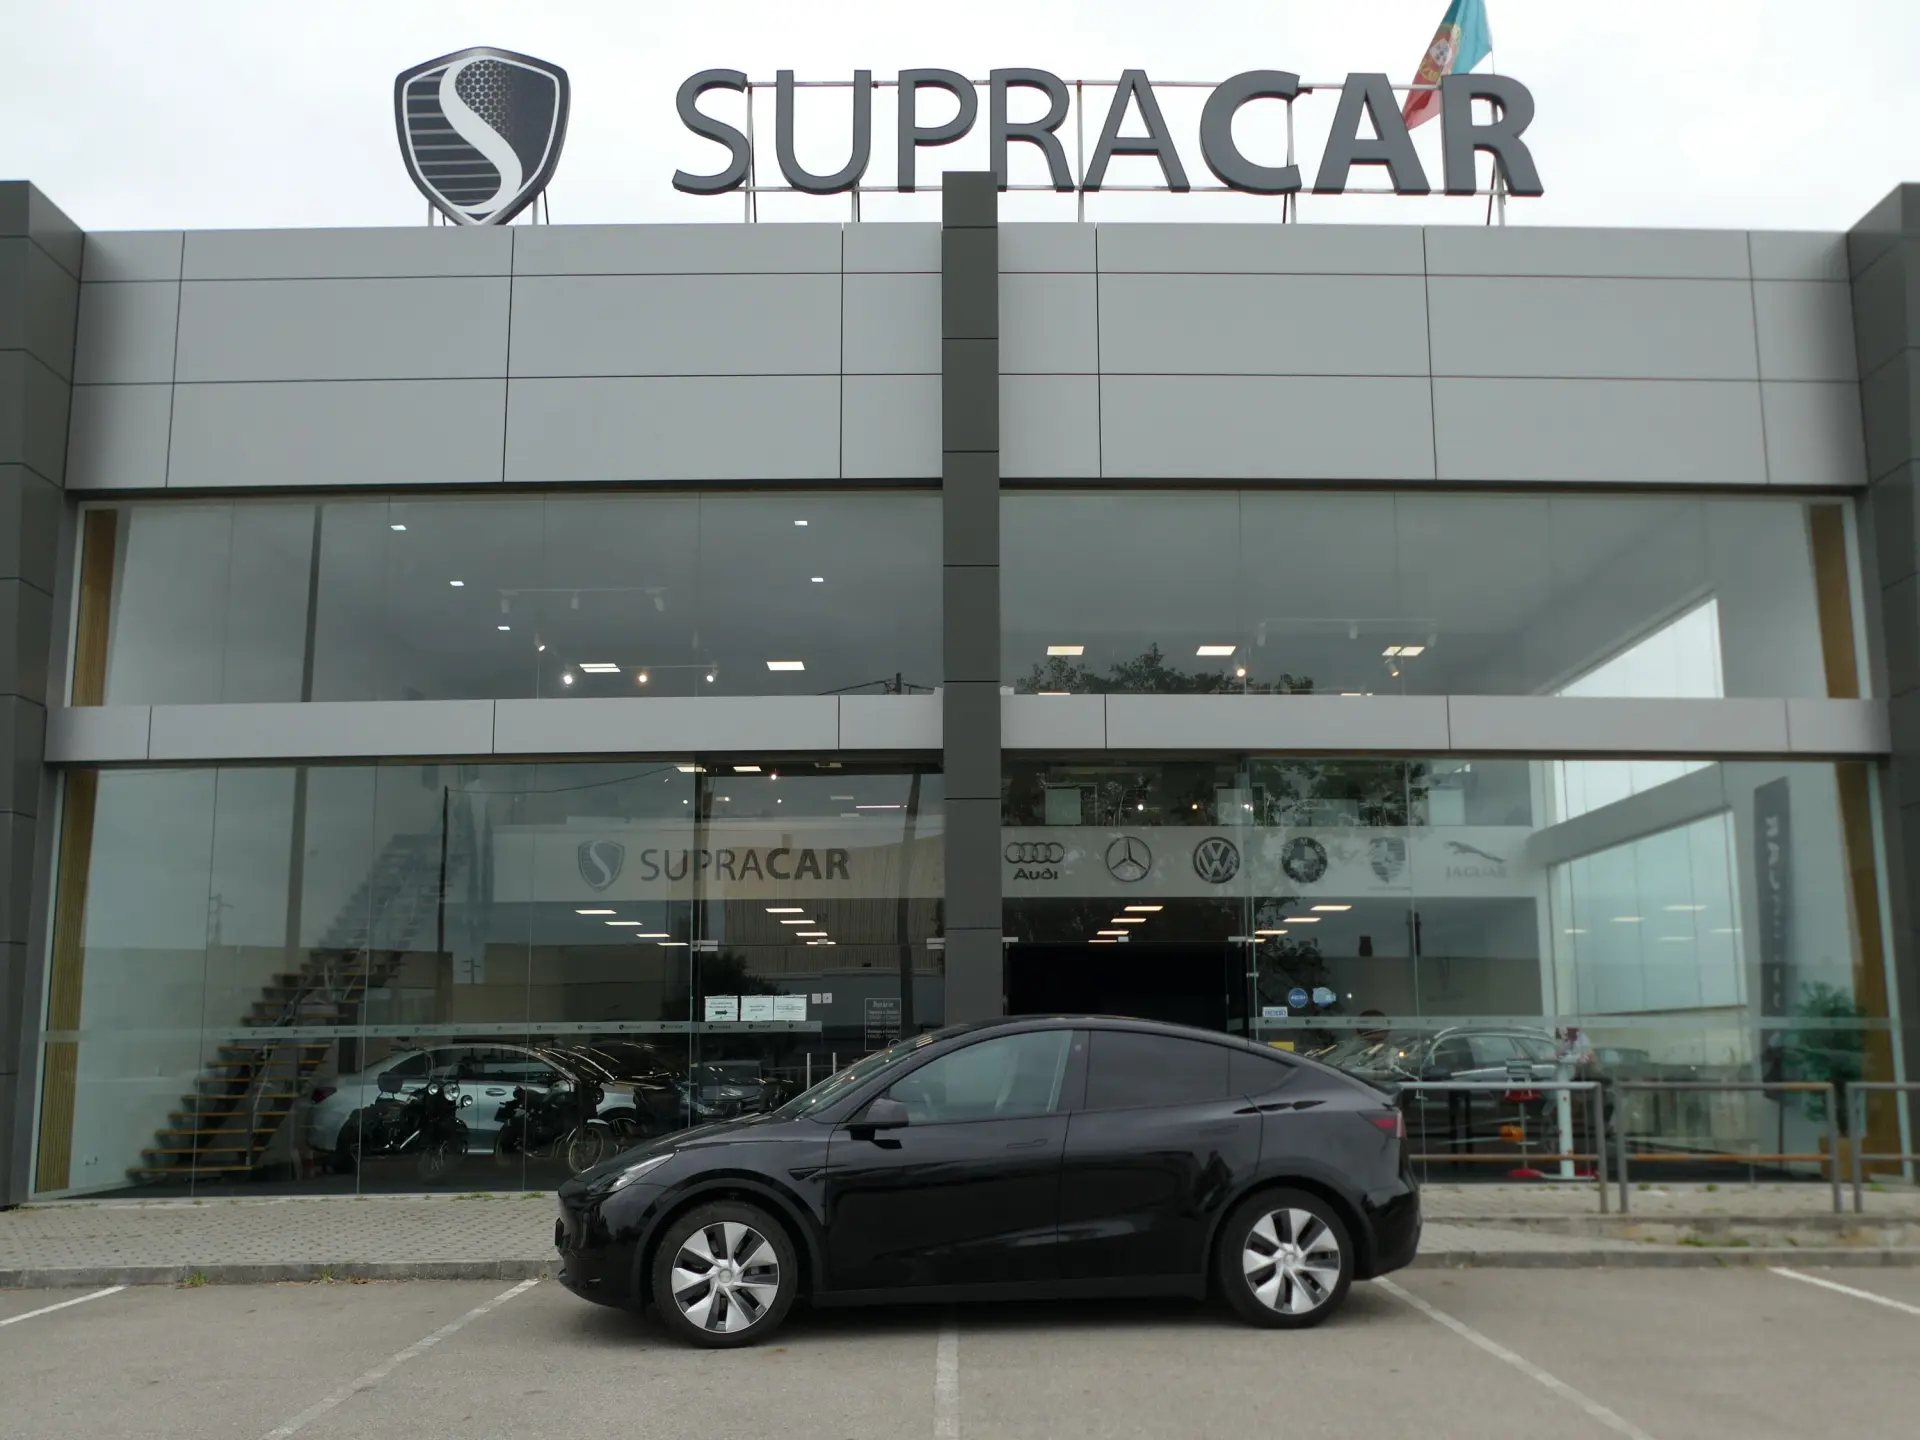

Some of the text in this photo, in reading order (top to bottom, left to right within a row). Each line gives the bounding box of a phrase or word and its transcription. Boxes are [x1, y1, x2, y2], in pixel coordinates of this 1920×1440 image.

[672, 67, 1544, 196] SUPRACAR
[640, 847, 850, 882] SUPRACAR
[1013, 868, 1059, 880] Audi
